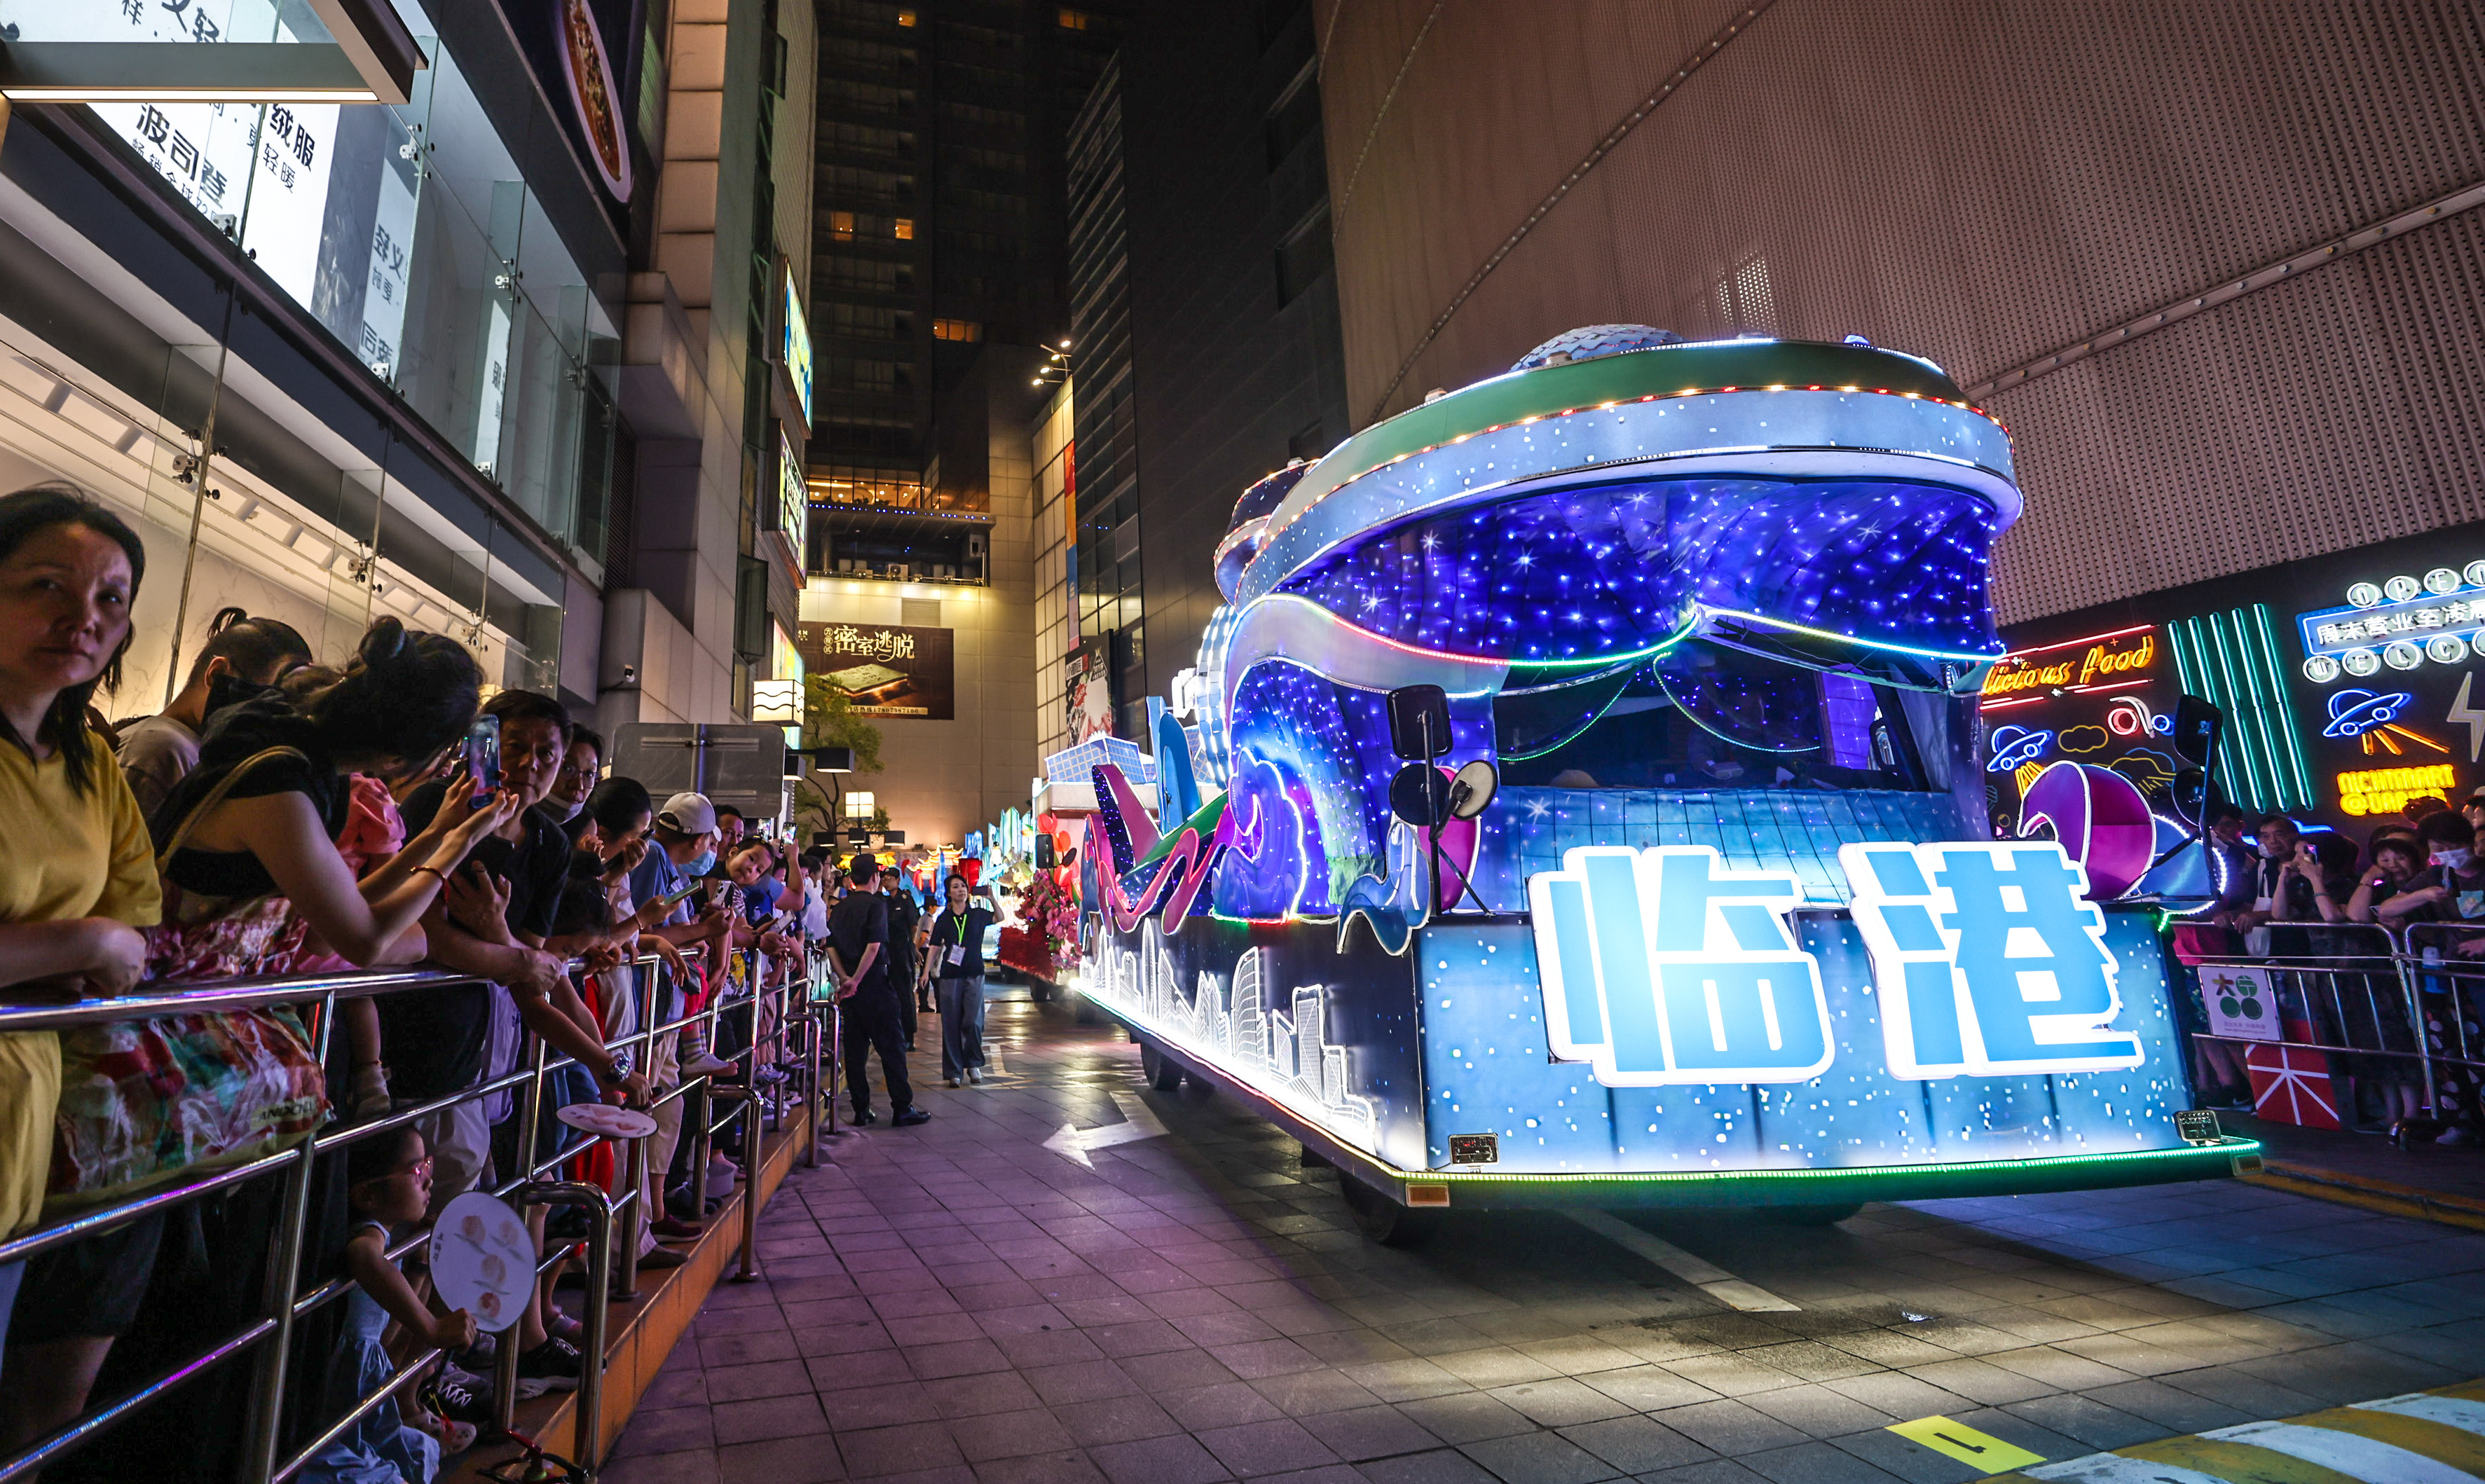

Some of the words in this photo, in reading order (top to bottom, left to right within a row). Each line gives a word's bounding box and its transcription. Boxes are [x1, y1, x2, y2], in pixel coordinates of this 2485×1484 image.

[136, 103, 228, 209] 波司登
[834, 625, 915, 662] 密室逃脱
[2079, 635, 2153, 684] food
[1528, 844, 2147, 1087] 临港
